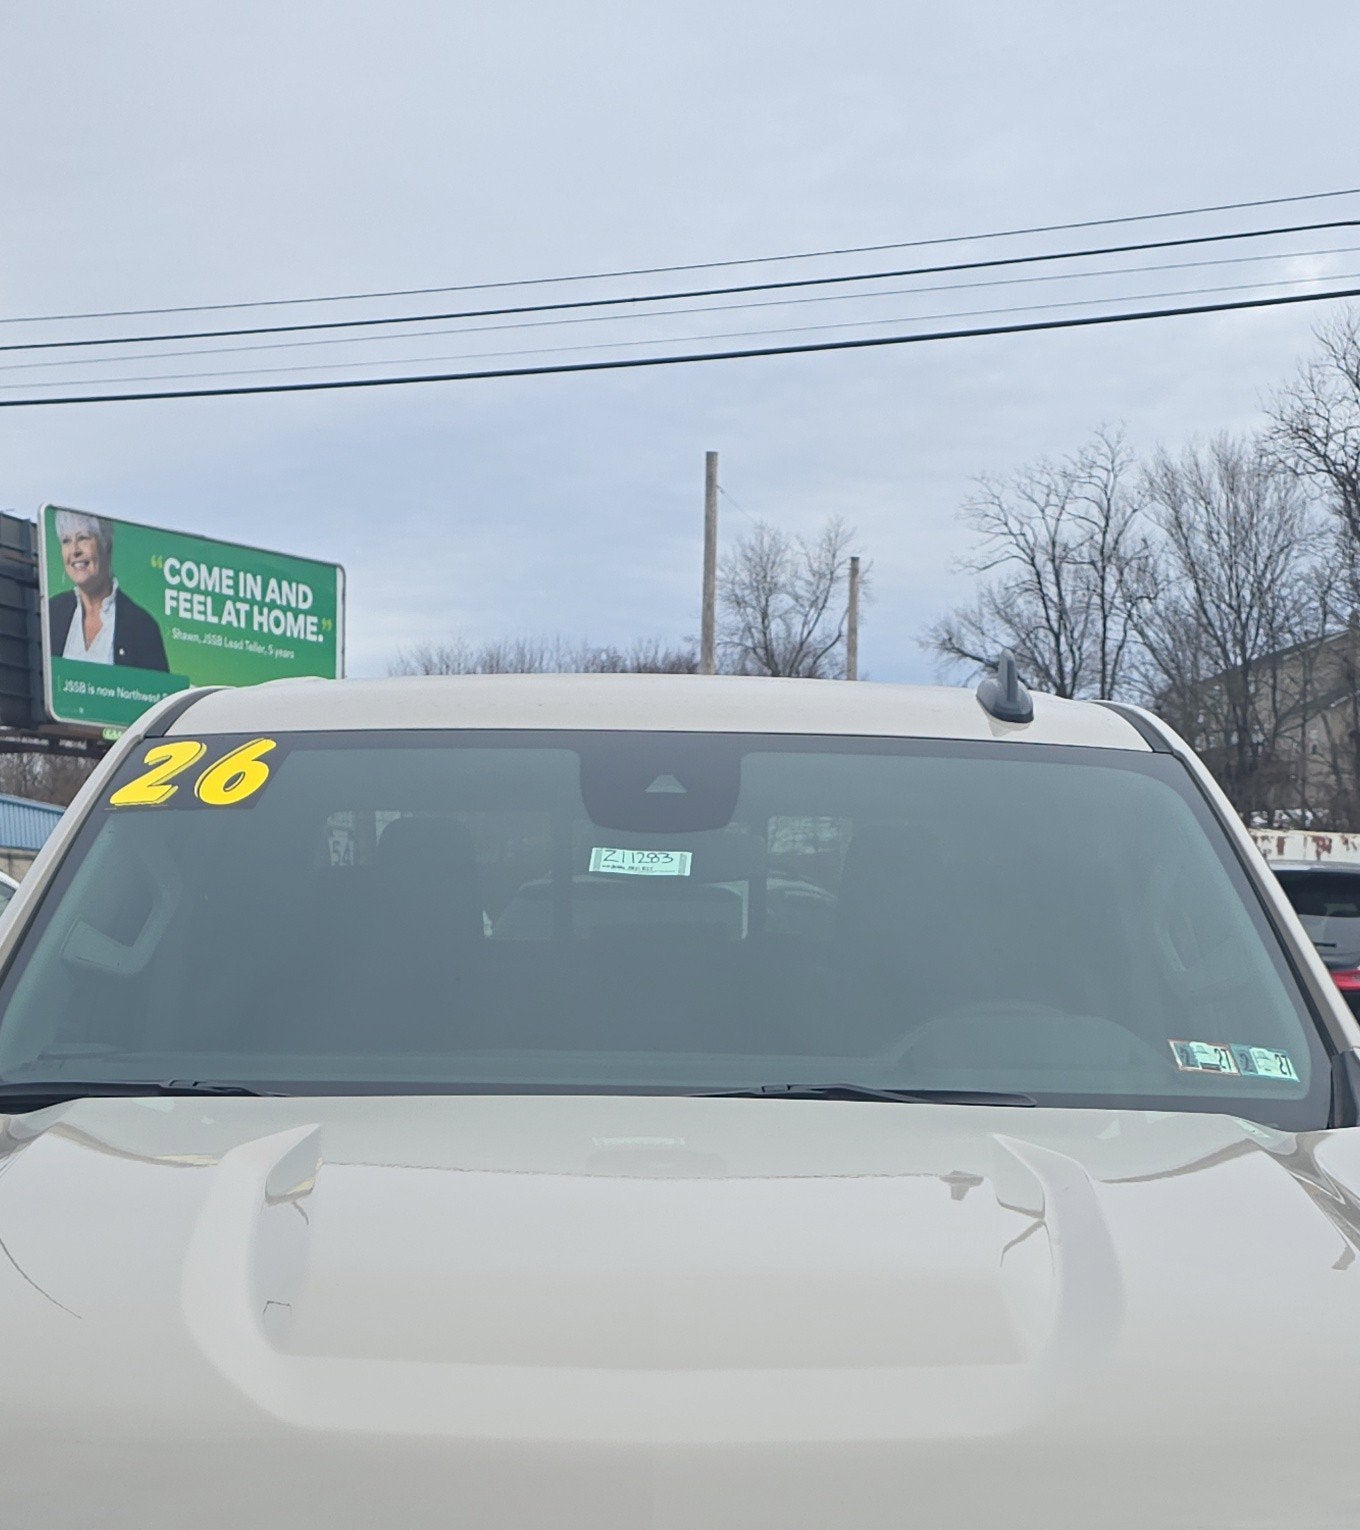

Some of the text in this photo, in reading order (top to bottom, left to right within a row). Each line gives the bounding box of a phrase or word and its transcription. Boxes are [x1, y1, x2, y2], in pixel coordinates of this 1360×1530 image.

[239, 571, 262, 600] IN
[265, 578, 313, 609] AND
[164, 588, 218, 624] FEEL
[221, 600, 250, 629] AT
[224, 637, 244, 650] Lead
[275, 648, 295, 659] years
[63, 680, 86, 694] JSSB
[87, 683, 95, 695] is
[97, 687, 115, 697] now
[116, 687, 160, 702] Northwest
[109, 737, 277, 806] 26
[1274, 1054, 1292, 1076] 27
